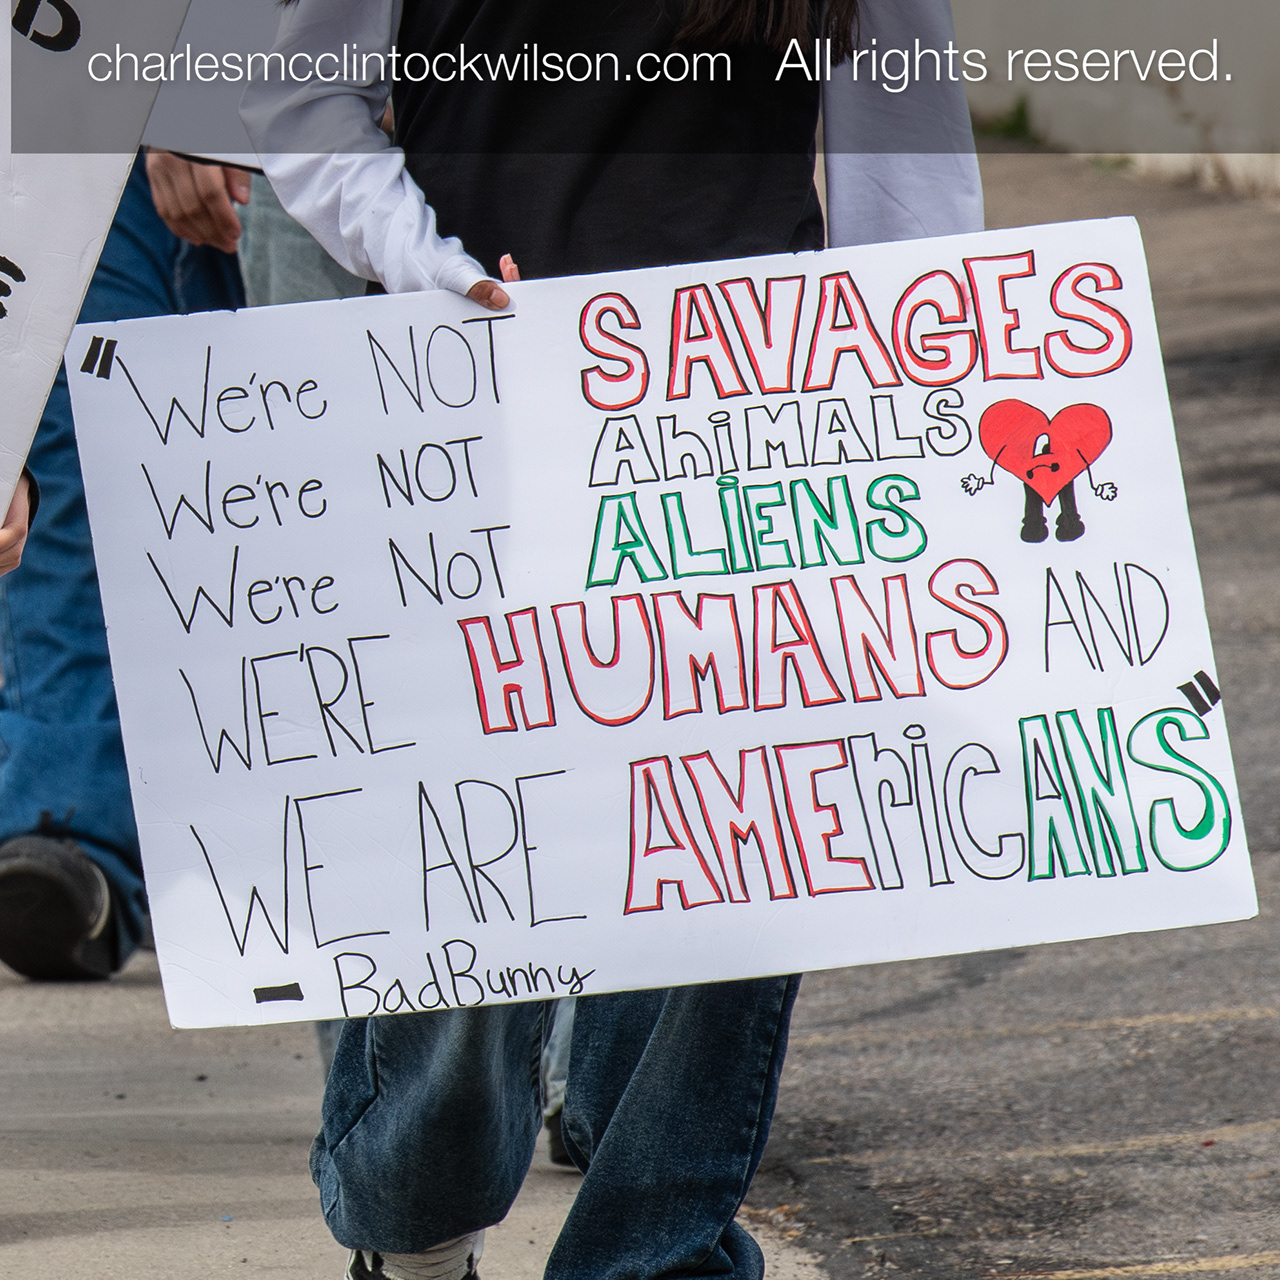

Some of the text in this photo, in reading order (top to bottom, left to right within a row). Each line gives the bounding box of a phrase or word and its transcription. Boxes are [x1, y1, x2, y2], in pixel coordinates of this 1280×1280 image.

[366, 313, 516, 415] NOT
[579, 250, 1133, 411] SAVAGES
[141, 460, 327, 540] We're
[376, 436, 483, 508] NOT
[146, 545, 339, 634] We're
[179, 558, 1170, 773] WE'RE HUMANS AND
[190, 788, 390, 956] WE
[419, 769, 587, 932] ARE
